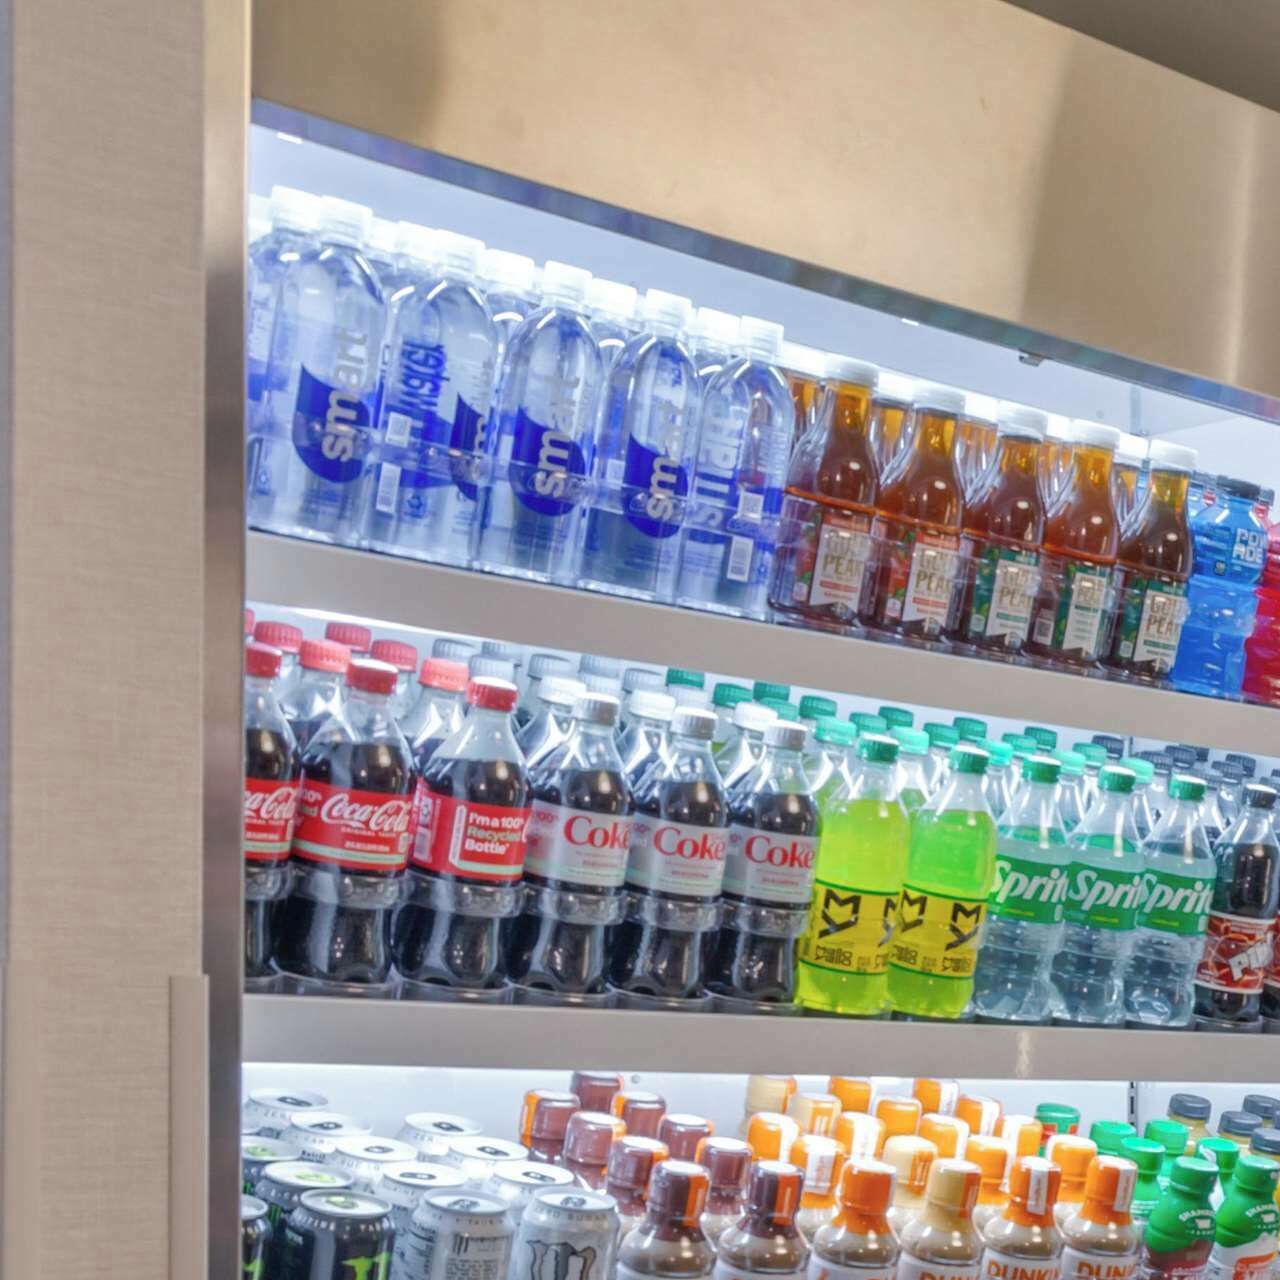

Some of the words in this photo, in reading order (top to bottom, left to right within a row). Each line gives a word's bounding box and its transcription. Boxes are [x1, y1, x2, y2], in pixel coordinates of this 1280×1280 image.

[322, 330, 369, 463] smart
[653, 826, 727, 861] Coke
[744, 835, 816, 869] Coke
